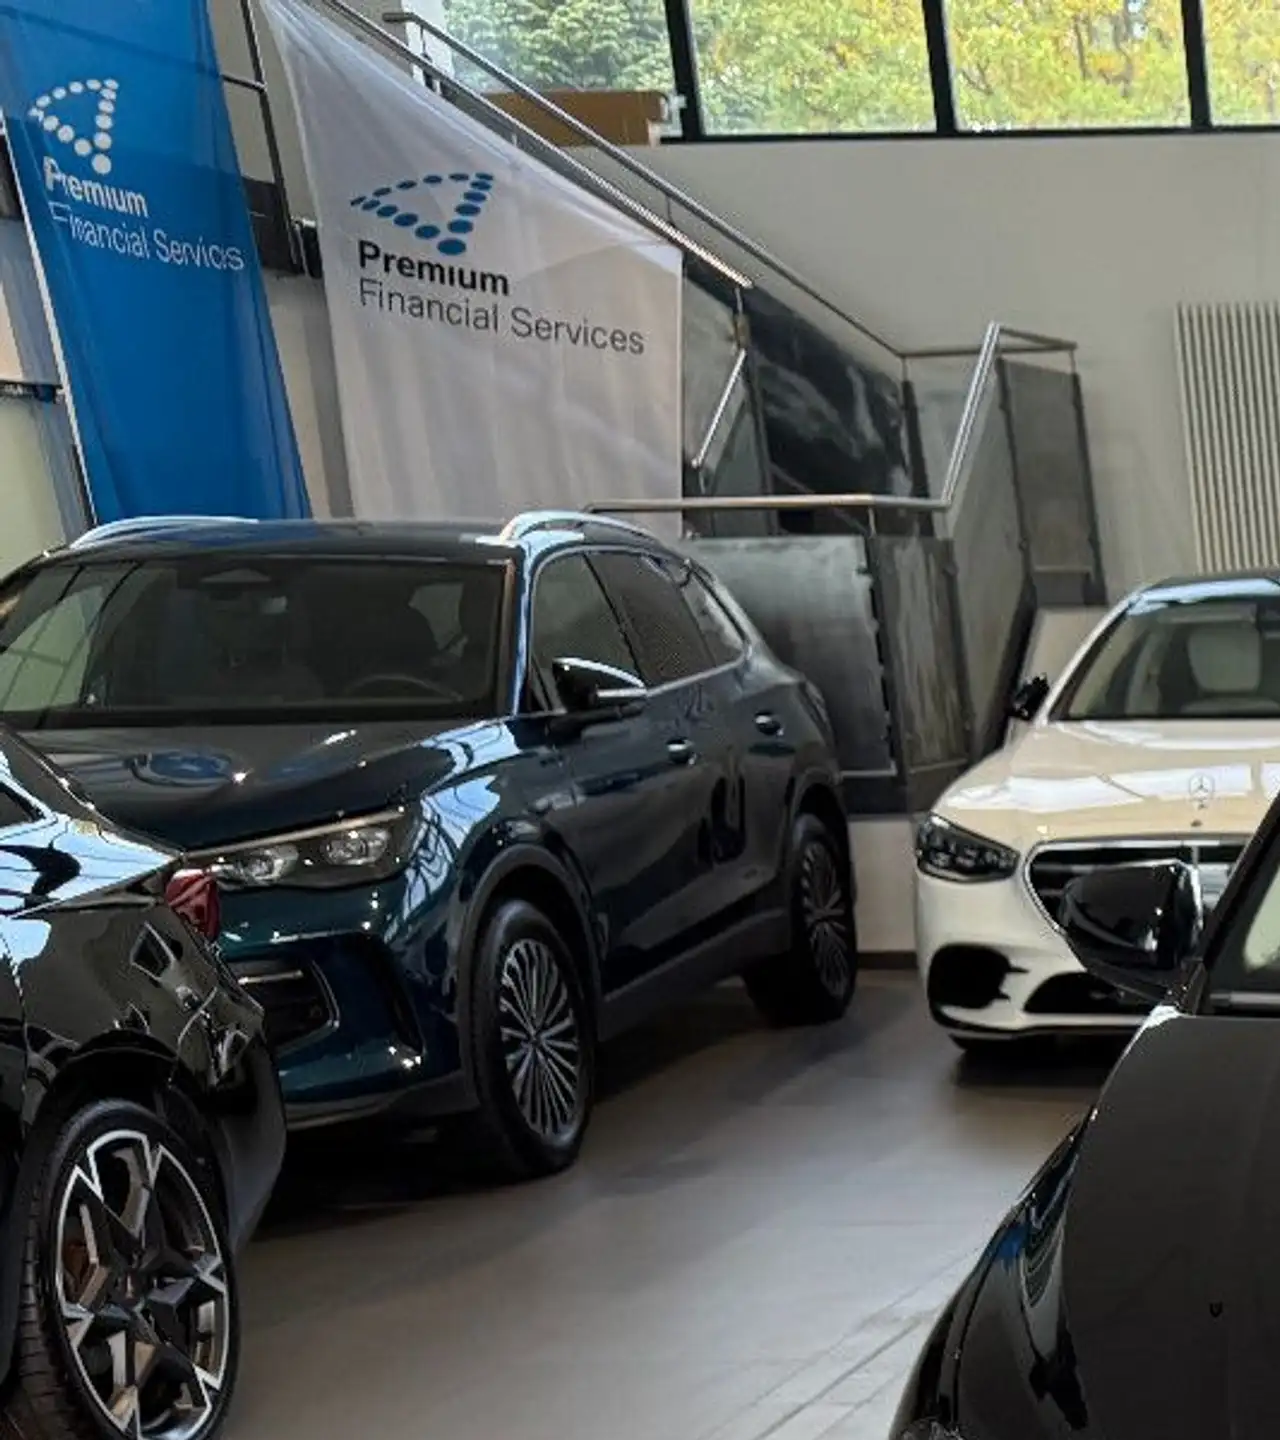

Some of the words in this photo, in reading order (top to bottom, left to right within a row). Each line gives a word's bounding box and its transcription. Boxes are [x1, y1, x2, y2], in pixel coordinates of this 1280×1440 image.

[358, 240, 510, 297] Premium
[359, 277, 499, 334] Financial
[510, 306, 645, 355] Services
